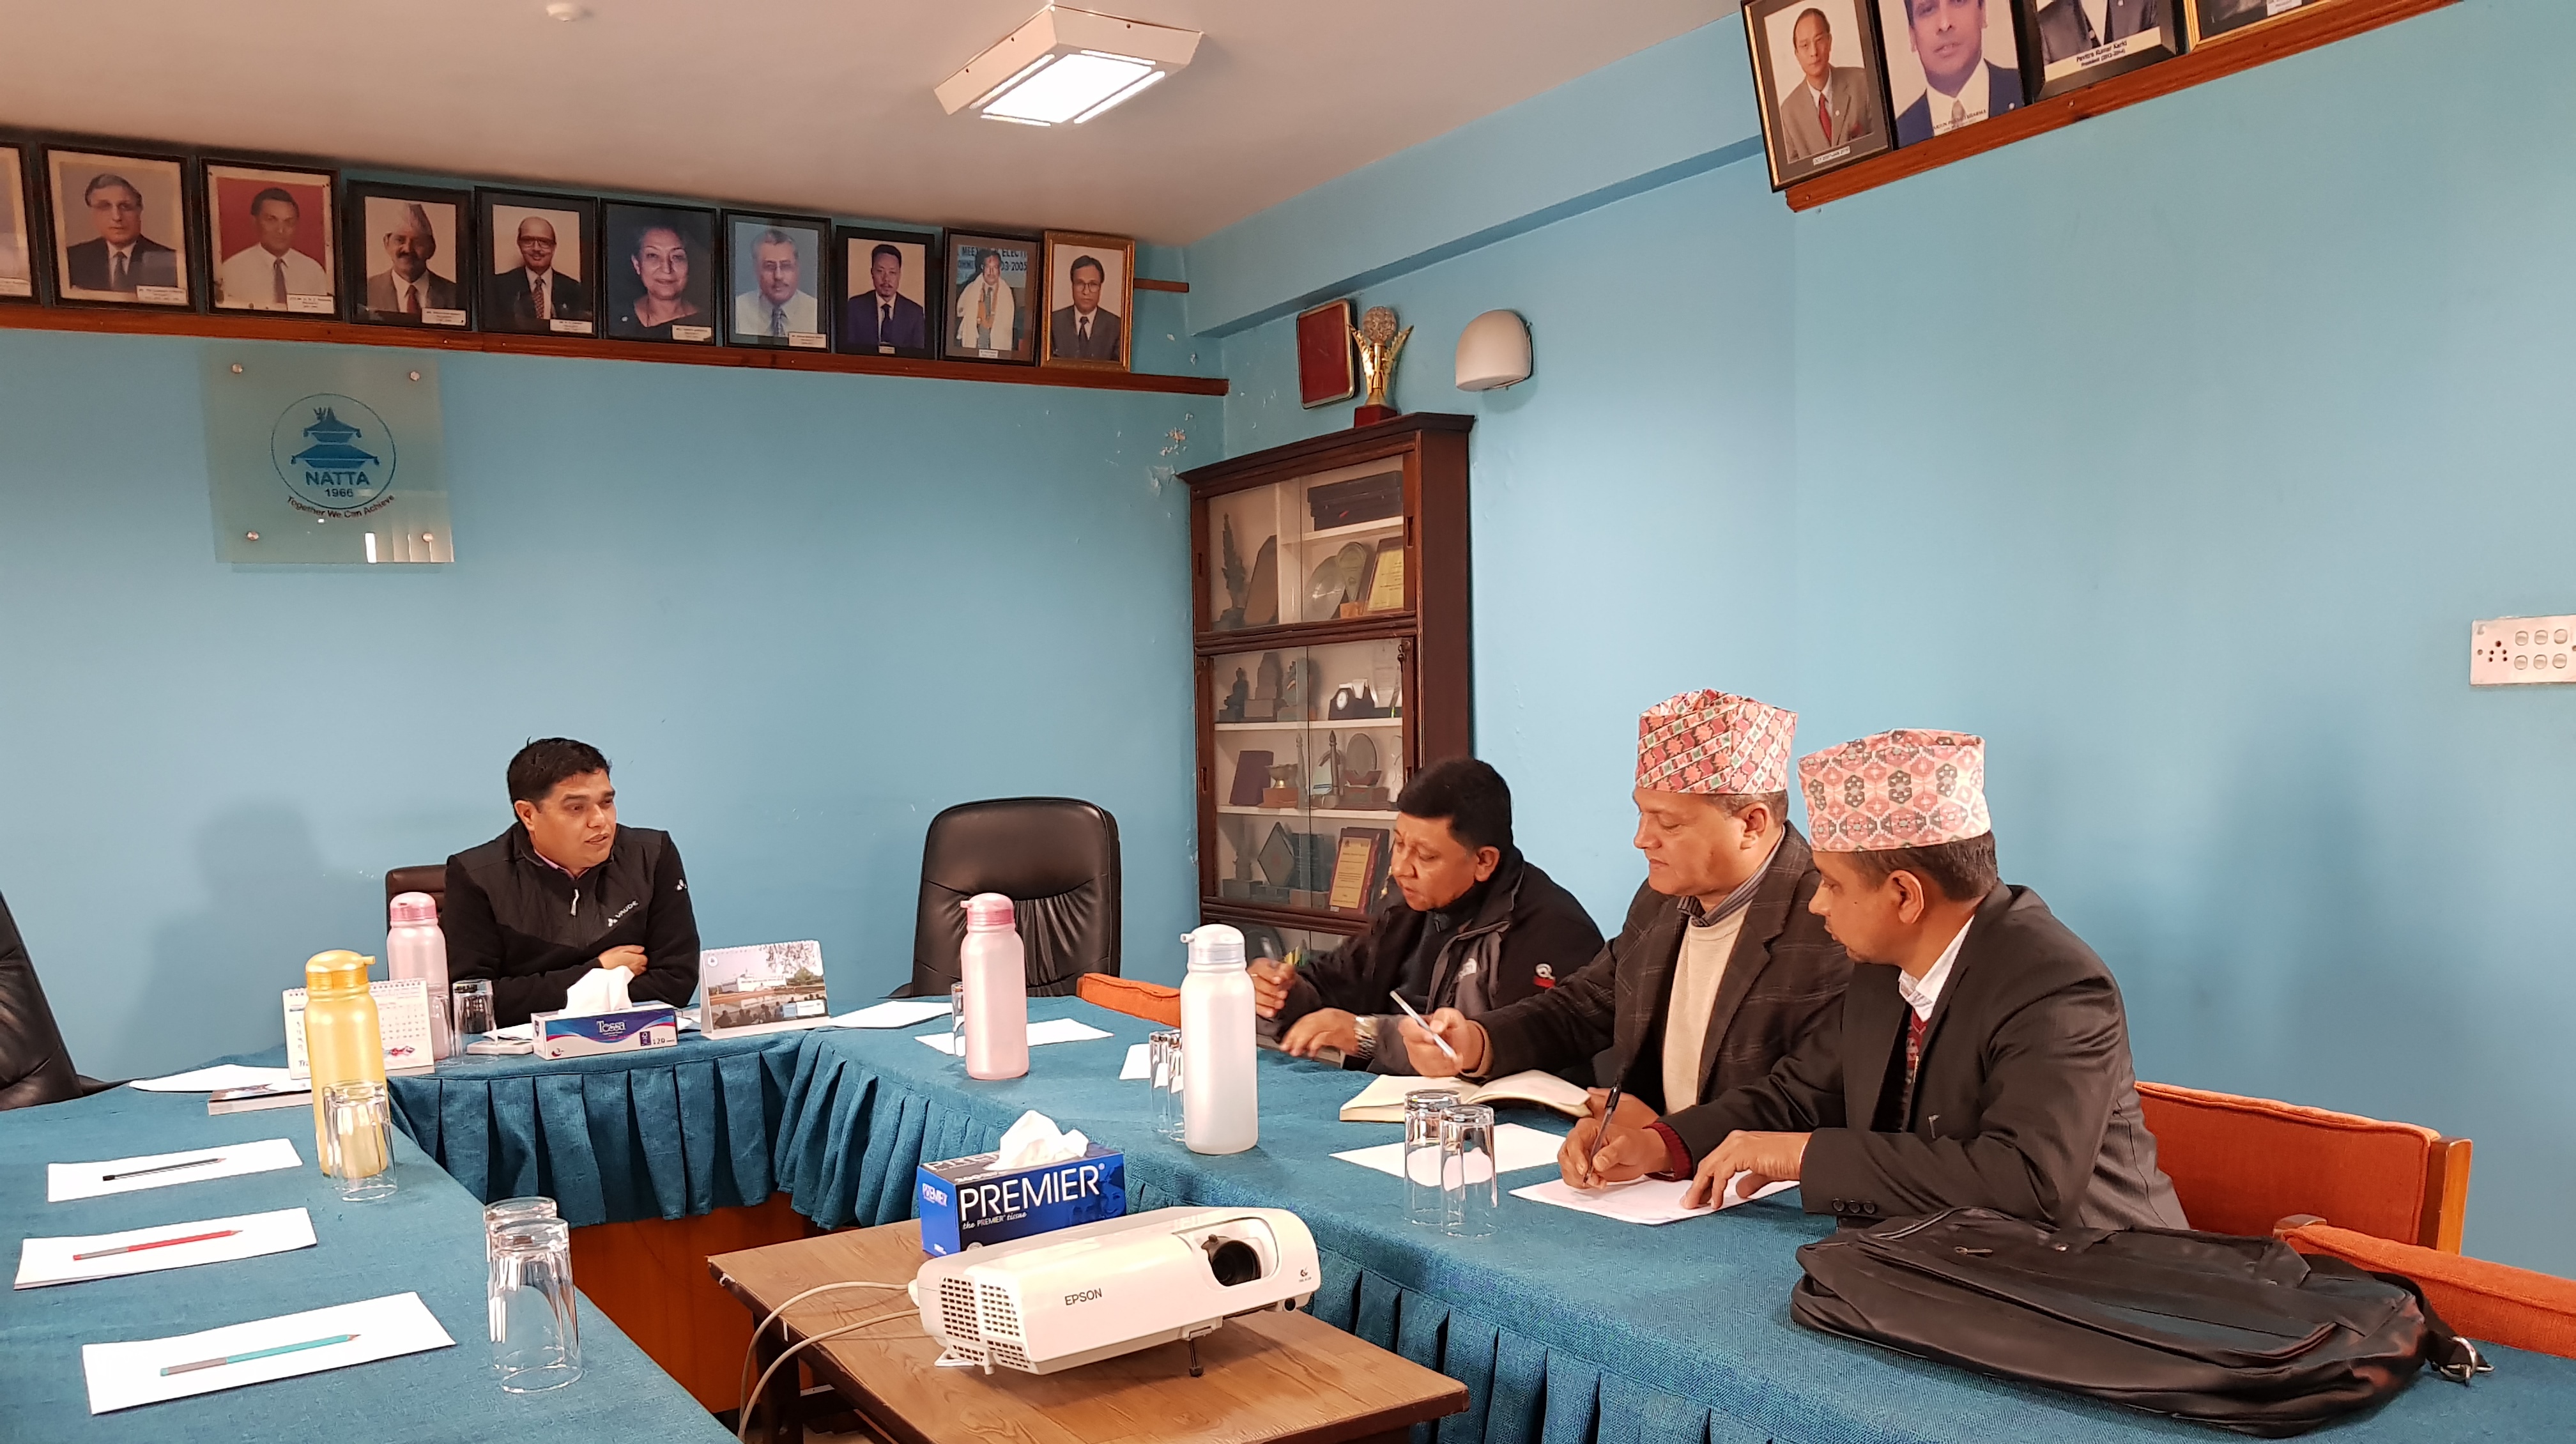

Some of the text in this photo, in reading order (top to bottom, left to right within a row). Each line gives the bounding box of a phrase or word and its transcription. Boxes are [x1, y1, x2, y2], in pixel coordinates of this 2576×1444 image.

[305, 471, 370, 486] NATTA
[325, 488, 354, 497] 1966
[288, 495, 325, 516] Together
[327, 510, 342, 518] We
[364, 495, 395, 515] Achieve
[960, 1165, 1100, 1222] PREMIER
[962, 1221, 976, 1231] the
[1006, 1211, 1027, 1222] tissue
[1064, 1287, 1102, 1306] EPSON
